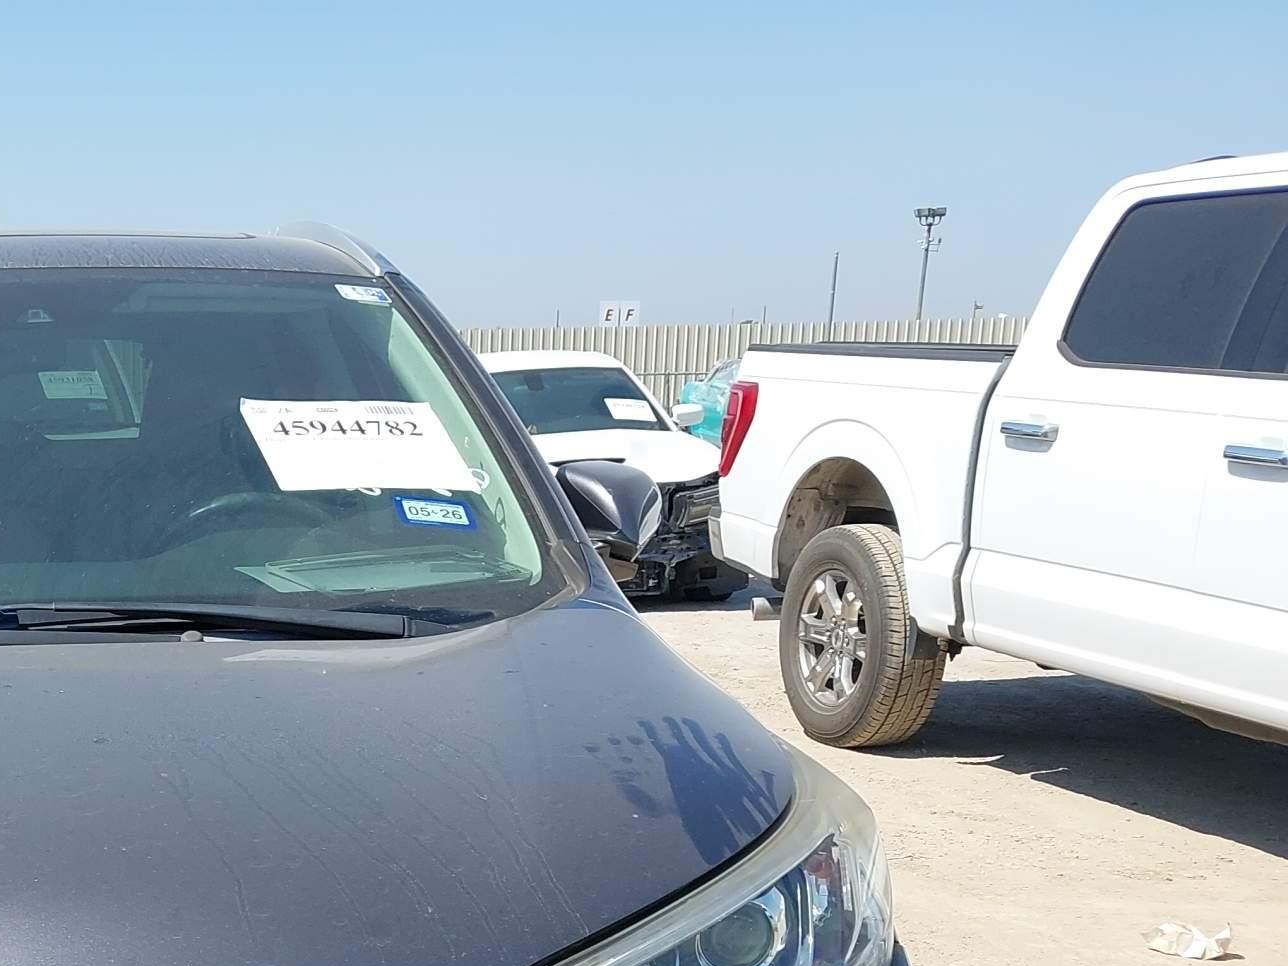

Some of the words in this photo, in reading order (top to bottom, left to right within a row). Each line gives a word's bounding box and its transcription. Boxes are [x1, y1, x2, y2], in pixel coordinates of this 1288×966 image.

[604, 308, 614, 322] E
[625, 308, 635, 322] F
[272, 420, 424, 437] 45944782
